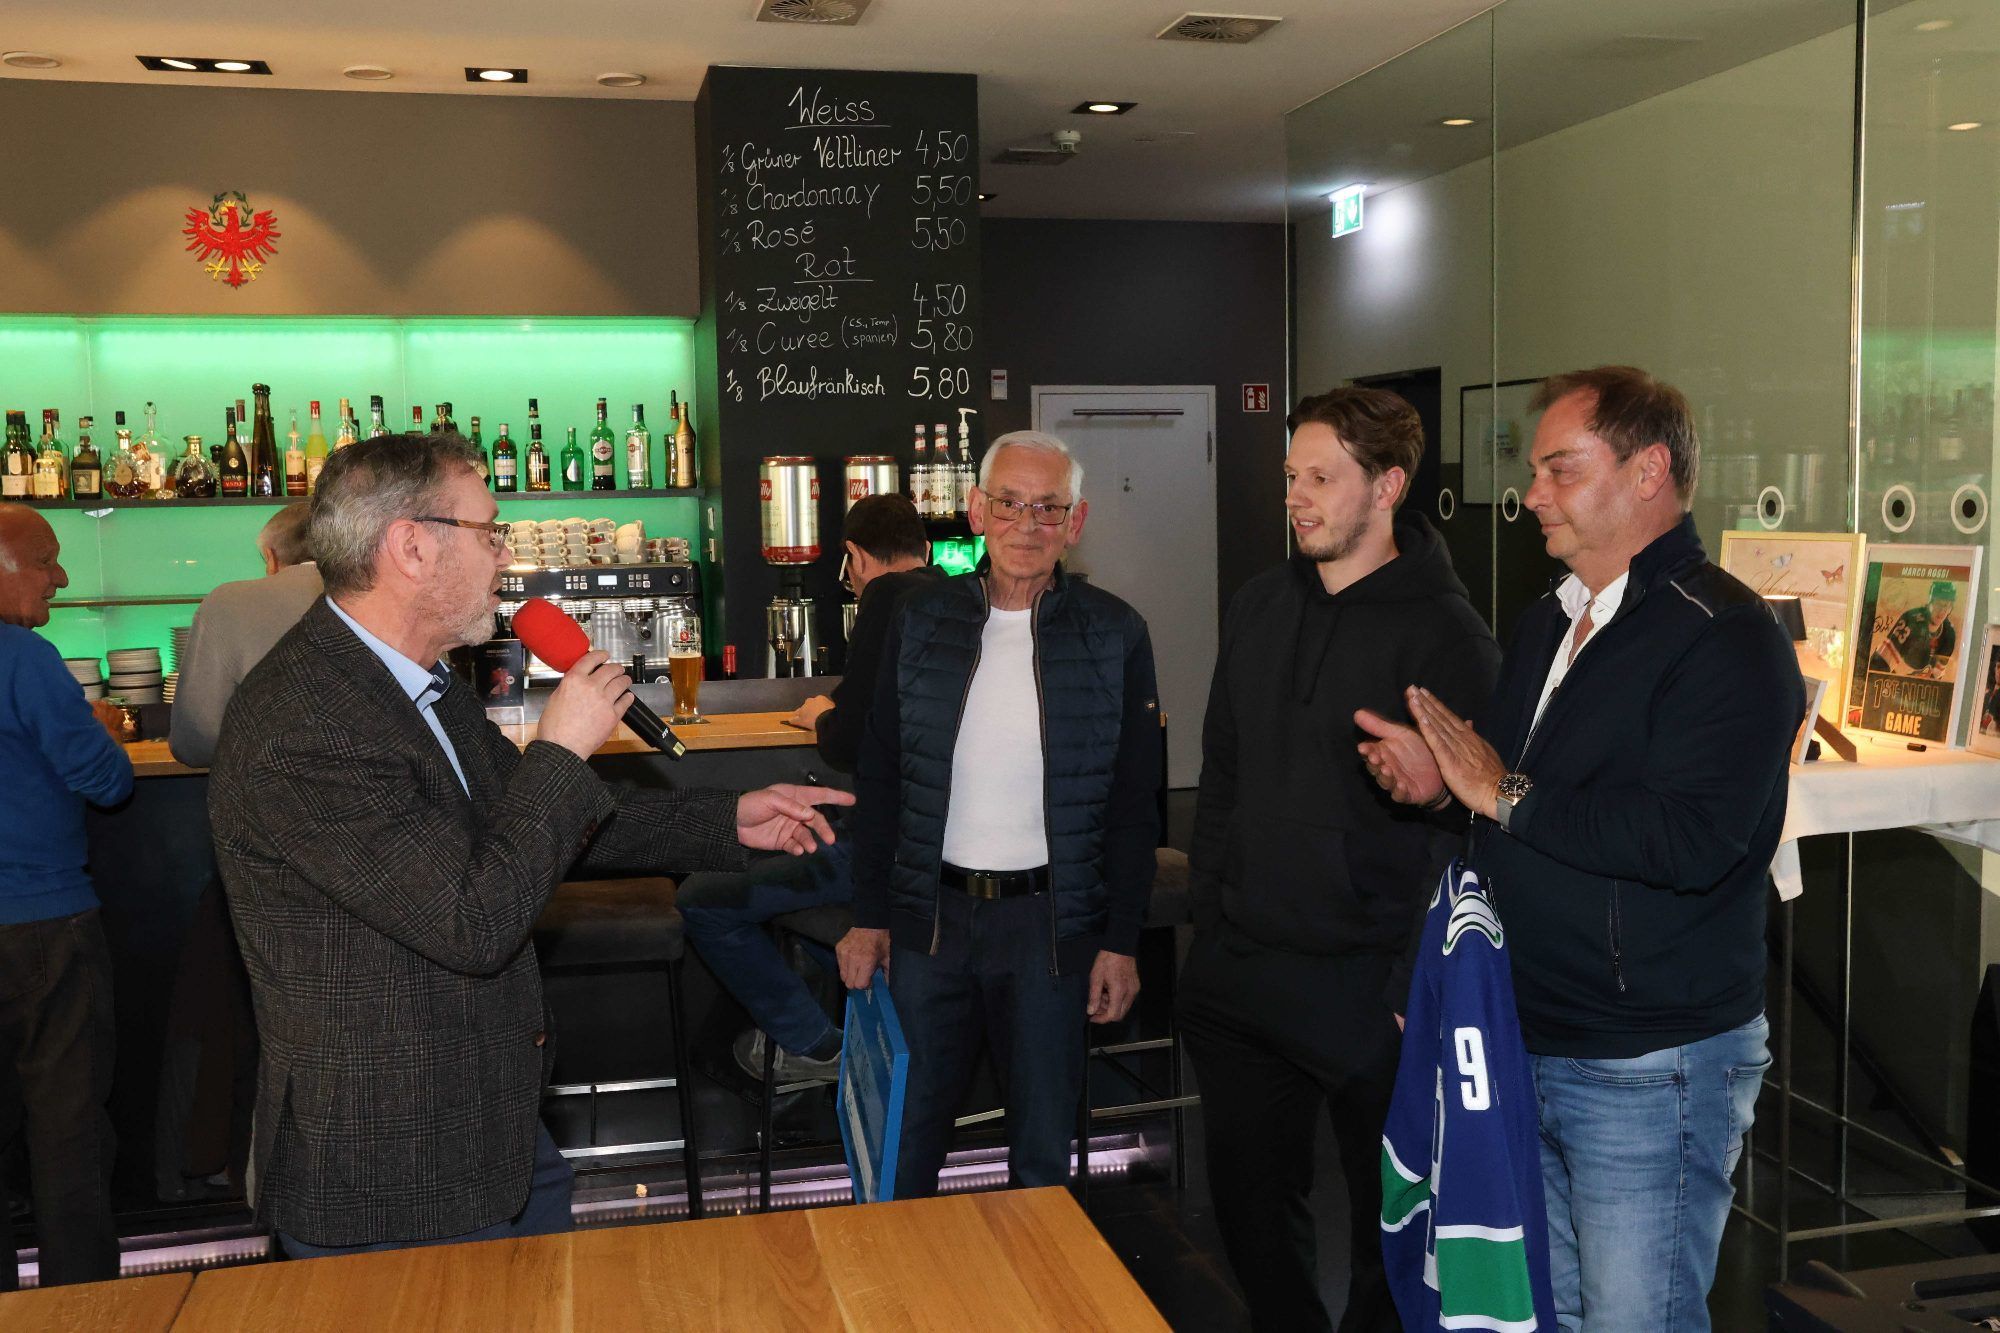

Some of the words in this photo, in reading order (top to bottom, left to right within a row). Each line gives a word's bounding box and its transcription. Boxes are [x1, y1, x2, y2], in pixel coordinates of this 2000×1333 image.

[788, 86, 875, 124] Weiss
[720, 144, 735, 173] 1/8
[741, 142, 802, 185] Grüner
[813, 134, 902, 169] Veltliner
[915, 129, 969, 168] 4,50
[720, 188, 738, 216] 1/8
[746, 177, 880, 219] Chardonnay
[911, 175, 972, 212] 5,50
[720, 228, 741, 255] 1/8
[746, 219, 816, 249] Rosé
[911, 217, 966, 251] 5,50
[795, 246, 856, 278] Rot
[725, 290, 747, 312] 1/8
[756, 285, 839, 323] Zweigelt
[913, 282, 966, 317] 4,50
[726, 328, 748, 352] 1/8
[910, 319, 974, 355] 5,80
[726, 369, 743, 401] 1/8
[756, 363, 885, 401] Blaufränkisch
[907, 366, 969, 400] 5,80
[850, 479, 868, 497] illy
[1901, 566, 1926, 578] MARCO
[1893, 619, 1911, 643] 23
[1885, 711, 1922, 736] GAME
[1454, 1026, 1491, 1111] 9
